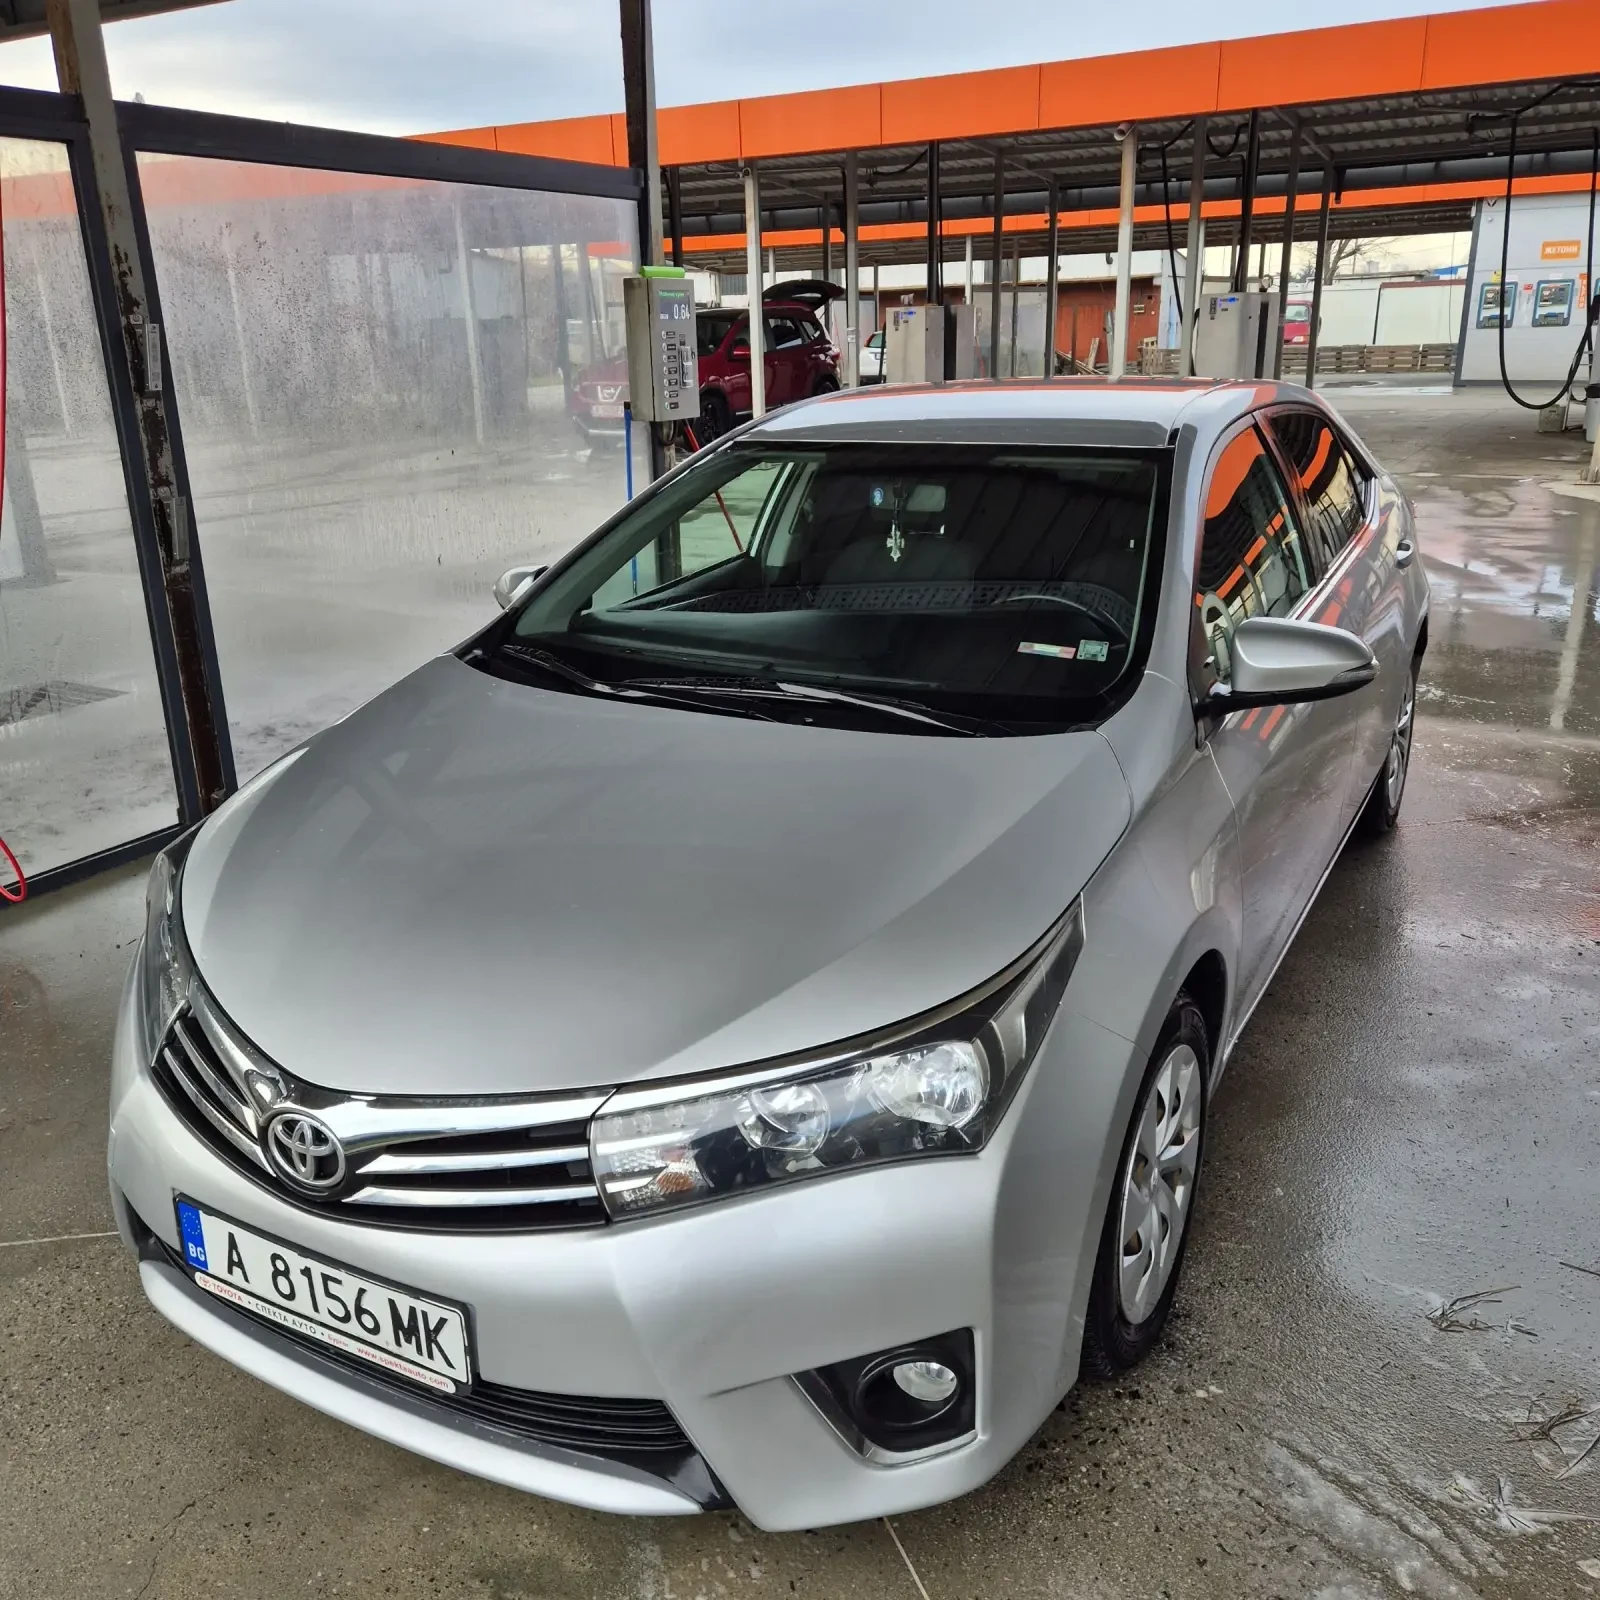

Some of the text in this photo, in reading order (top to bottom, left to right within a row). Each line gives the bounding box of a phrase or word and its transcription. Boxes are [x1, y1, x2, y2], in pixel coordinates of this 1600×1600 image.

[1544, 245, 1578, 254] ЖЕТОНИ
[673, 303, 690, 320] 0.64
[187, 1242, 205, 1262] BG
[212, 1283, 244, 1304] TOYOTA
[255, 1303, 289, 1323] СПЕКТА
[291, 1319, 317, 1335] АУТО
[227, 1231, 457, 1370] A 8156 MK
